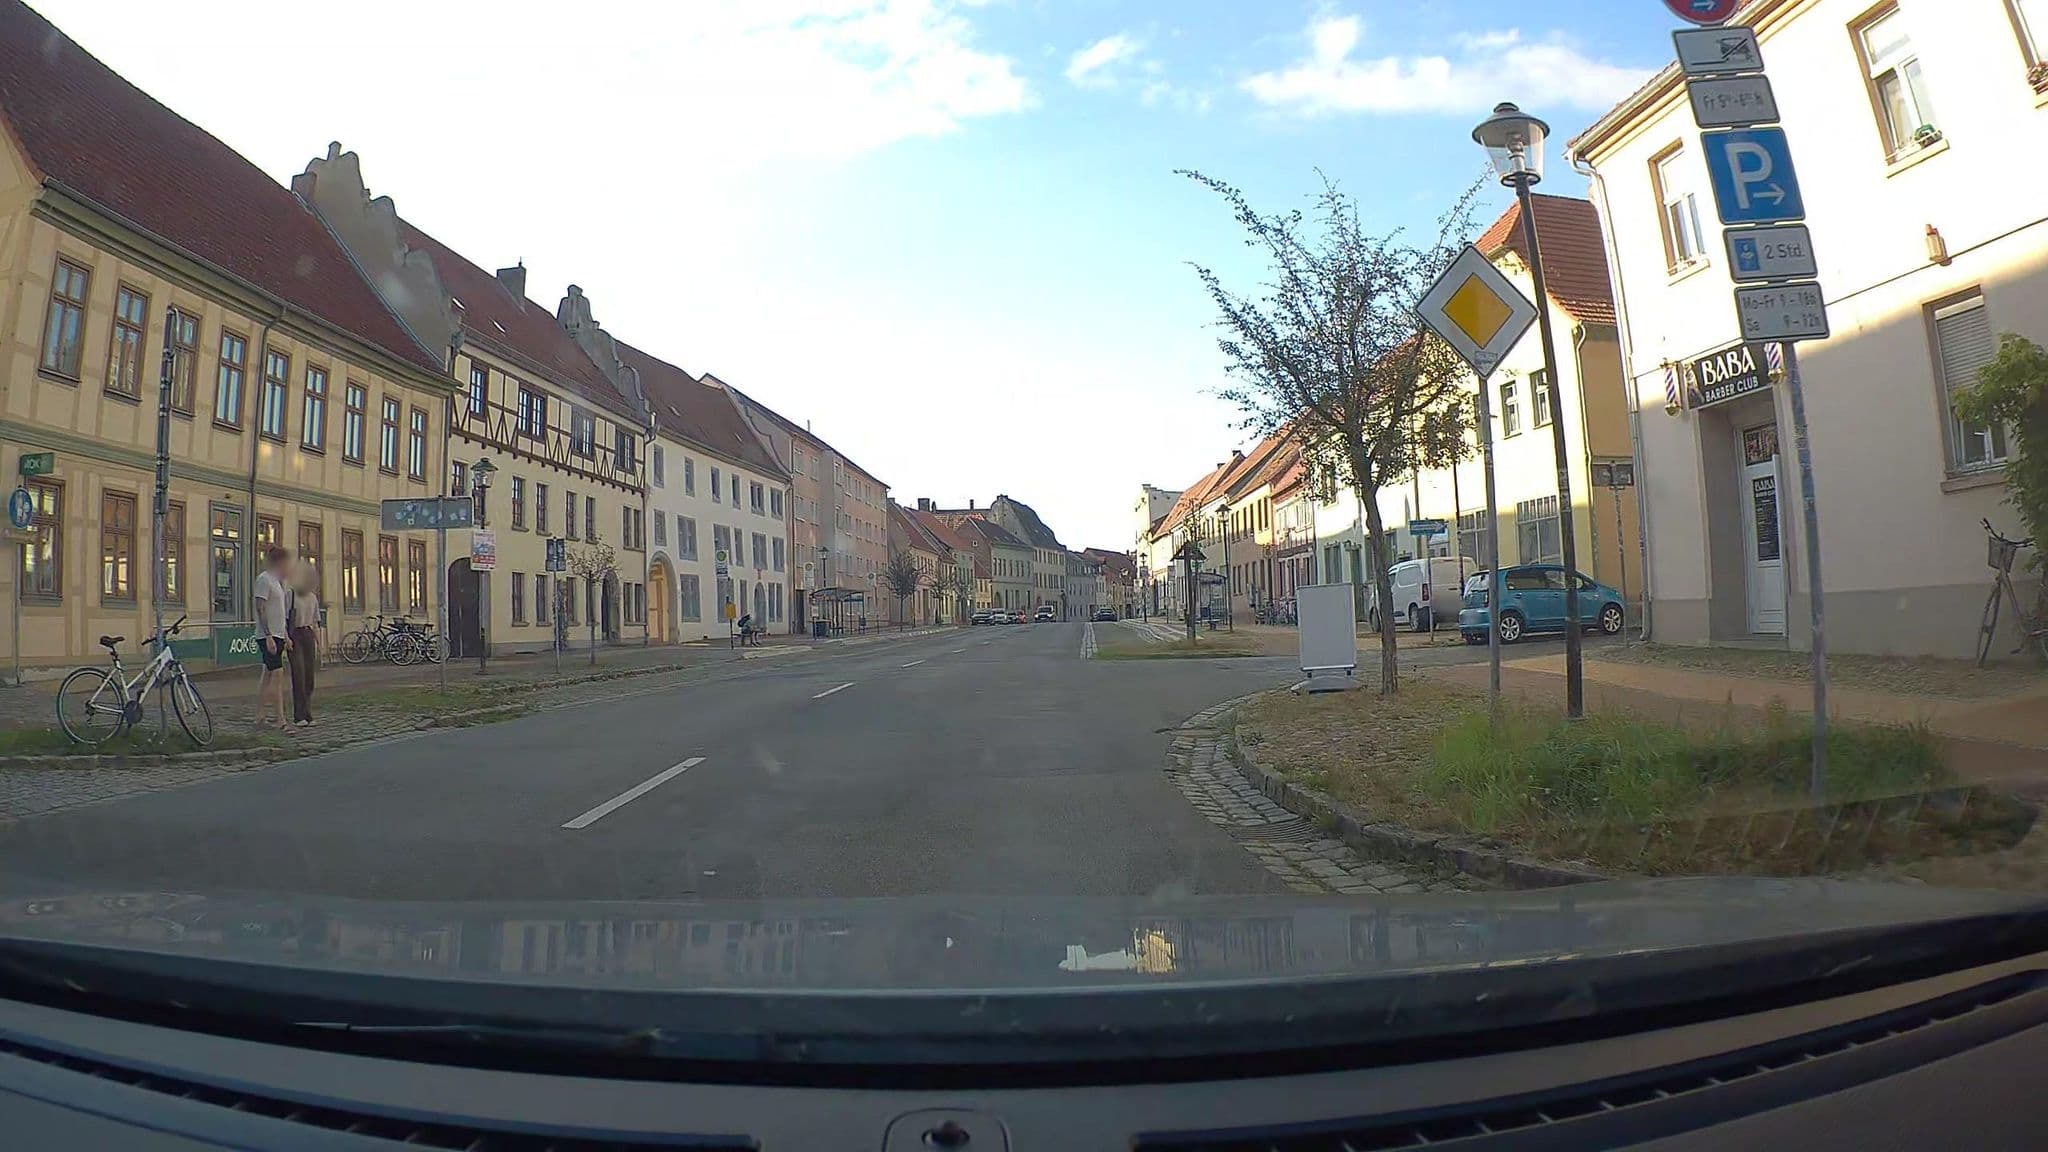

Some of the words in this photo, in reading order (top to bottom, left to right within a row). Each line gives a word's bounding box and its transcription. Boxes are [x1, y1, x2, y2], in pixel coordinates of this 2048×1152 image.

[1724, 142, 1772, 209] P
[1763, 244, 1775, 260] 2
[1777, 243, 1805, 259] Std.
[1742, 294, 1775, 310] Mo-Fr
[1745, 318, 1760, 331] Sa
[1701, 346, 1756, 386] BABA
[1705, 383, 1735, 402] BARBER
[1736, 375, 1759, 391] CLUB
[229, 638, 249, 653] AOK
